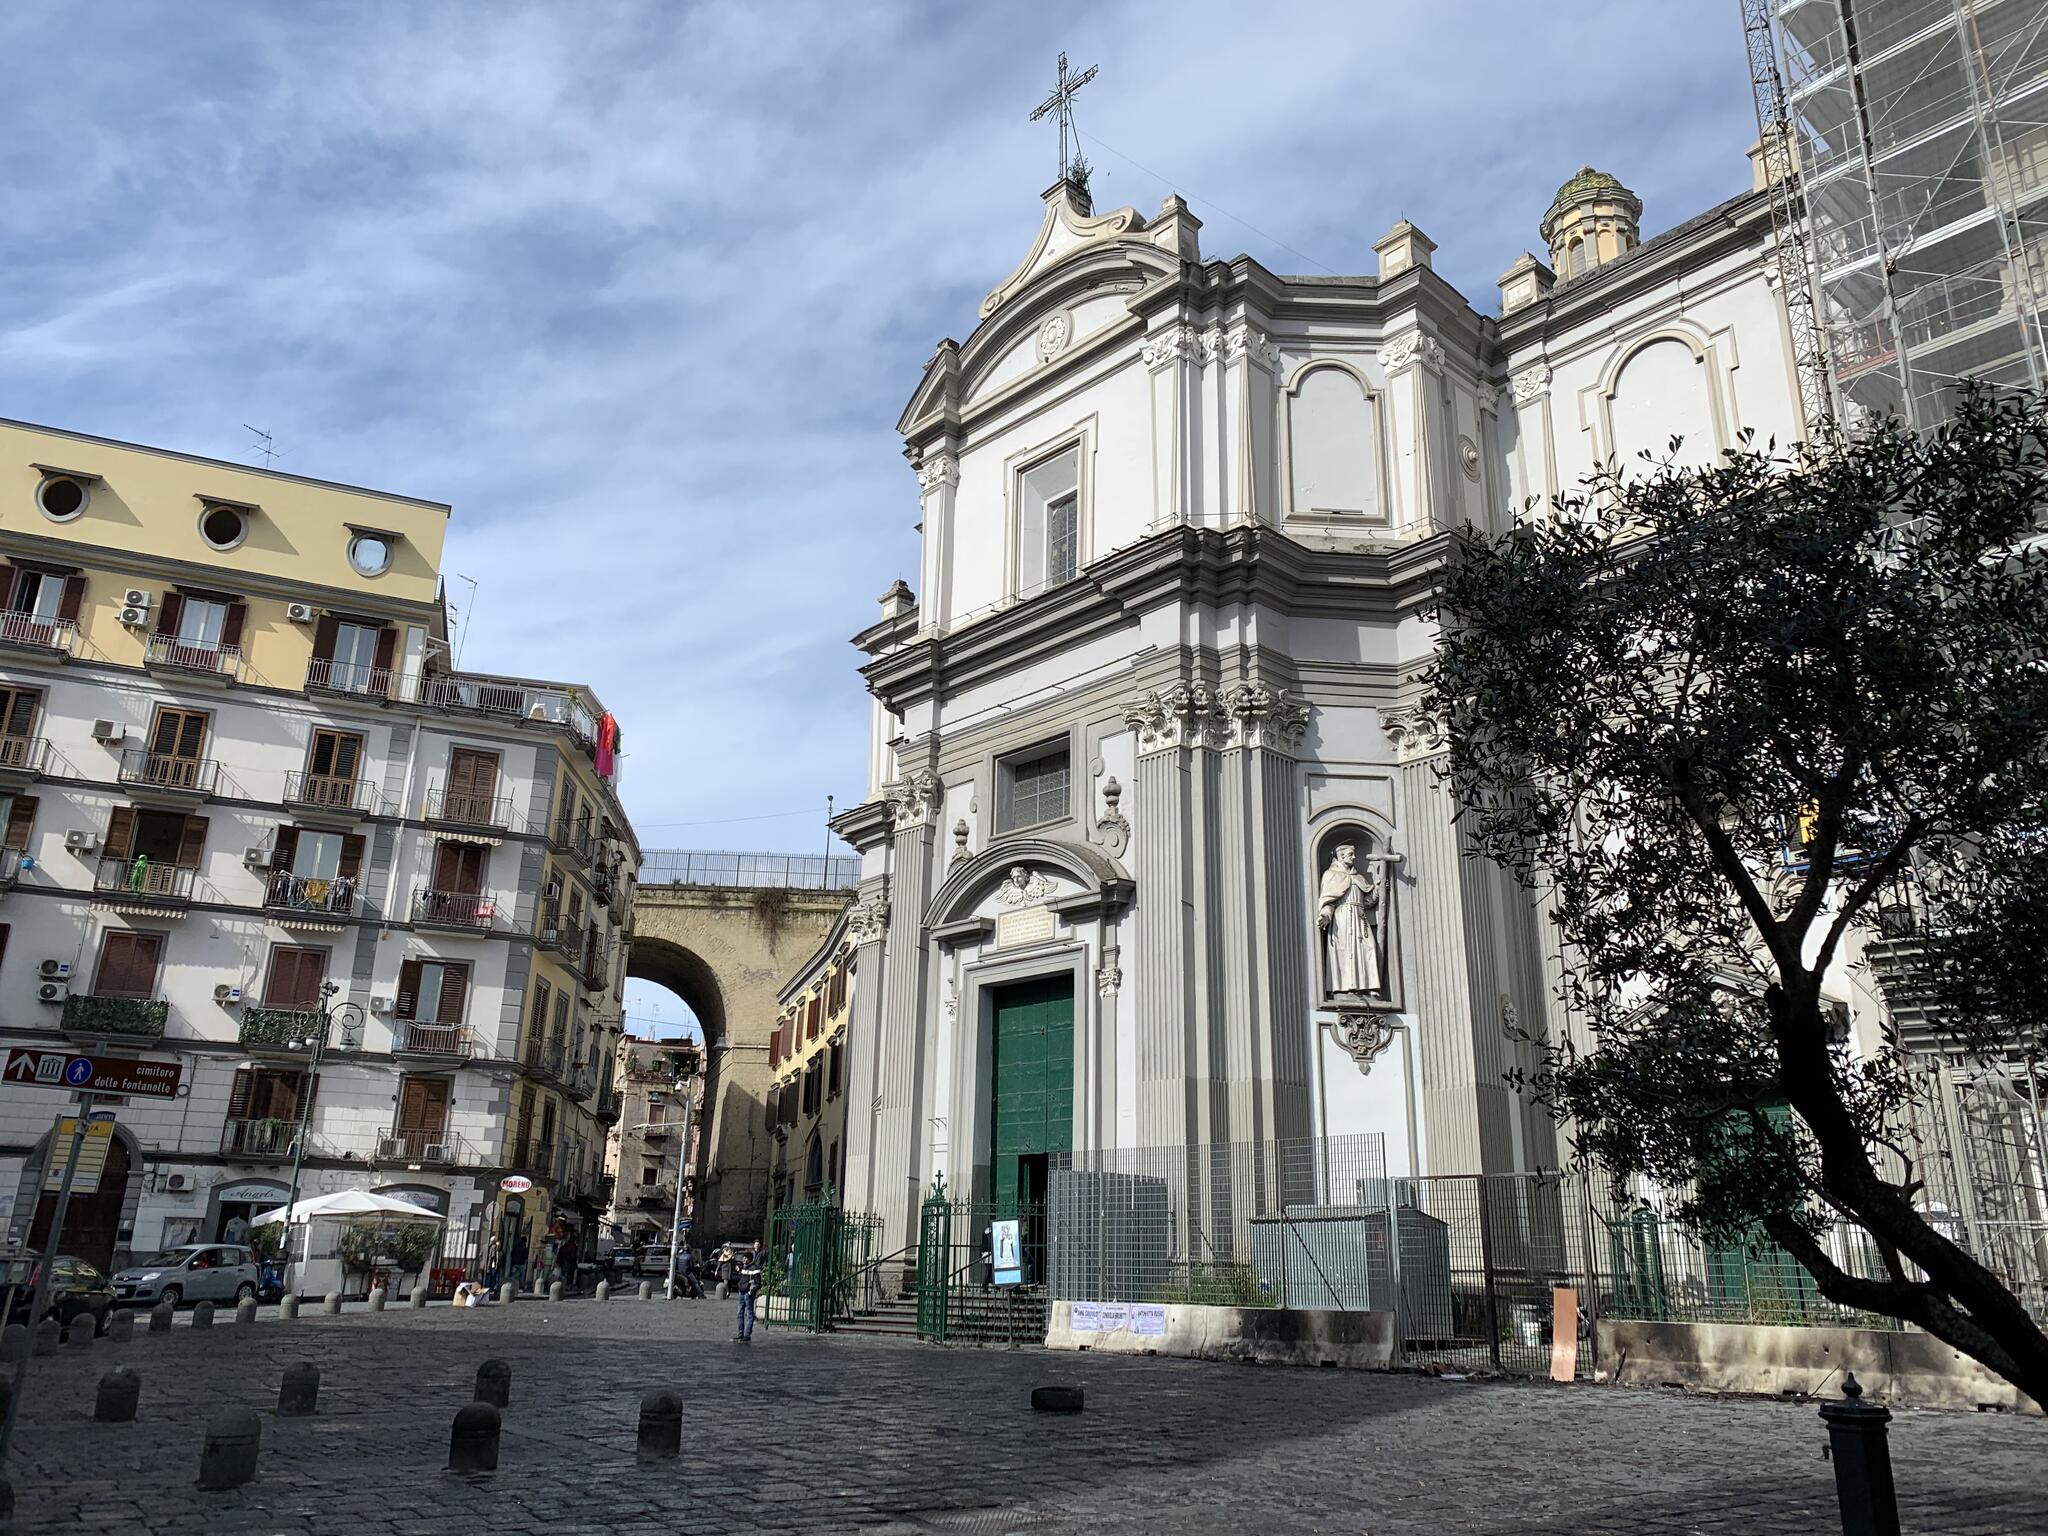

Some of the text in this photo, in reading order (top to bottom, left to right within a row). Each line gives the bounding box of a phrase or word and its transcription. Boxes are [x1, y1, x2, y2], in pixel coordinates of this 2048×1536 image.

[136, 1064, 175, 1078] cimitero
[94, 1076, 171, 1093] delle Fontanelle
[502, 1180, 530, 1188] MORENO
[230, 1188, 274, 1200] Angels
